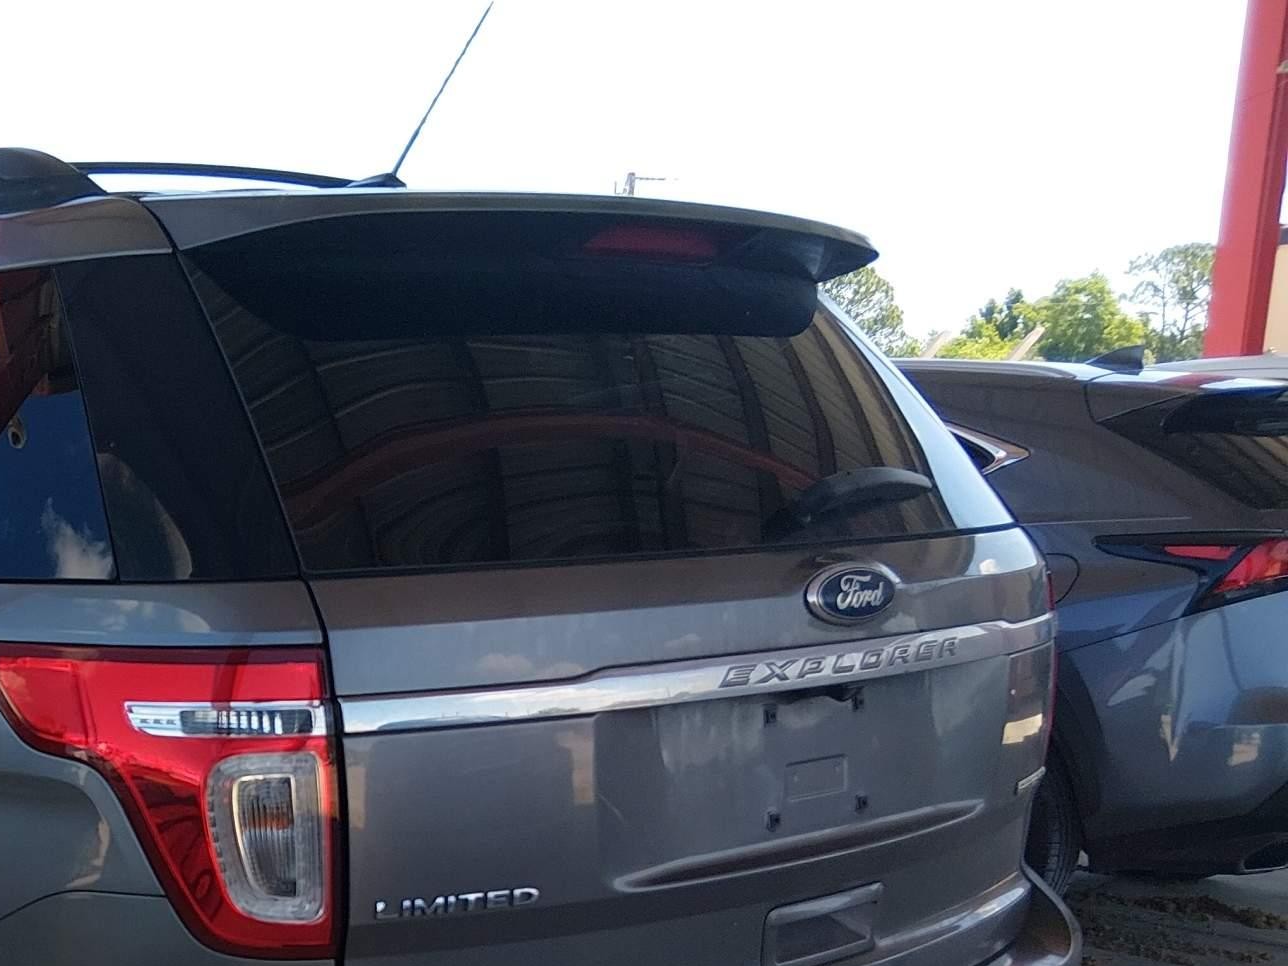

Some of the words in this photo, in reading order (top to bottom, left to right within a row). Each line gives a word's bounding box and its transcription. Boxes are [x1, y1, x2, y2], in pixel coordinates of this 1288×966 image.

[837, 575, 885, 610] Ford
[719, 636, 960, 688] EXPLORER
[376, 887, 540, 920] LIMITED
